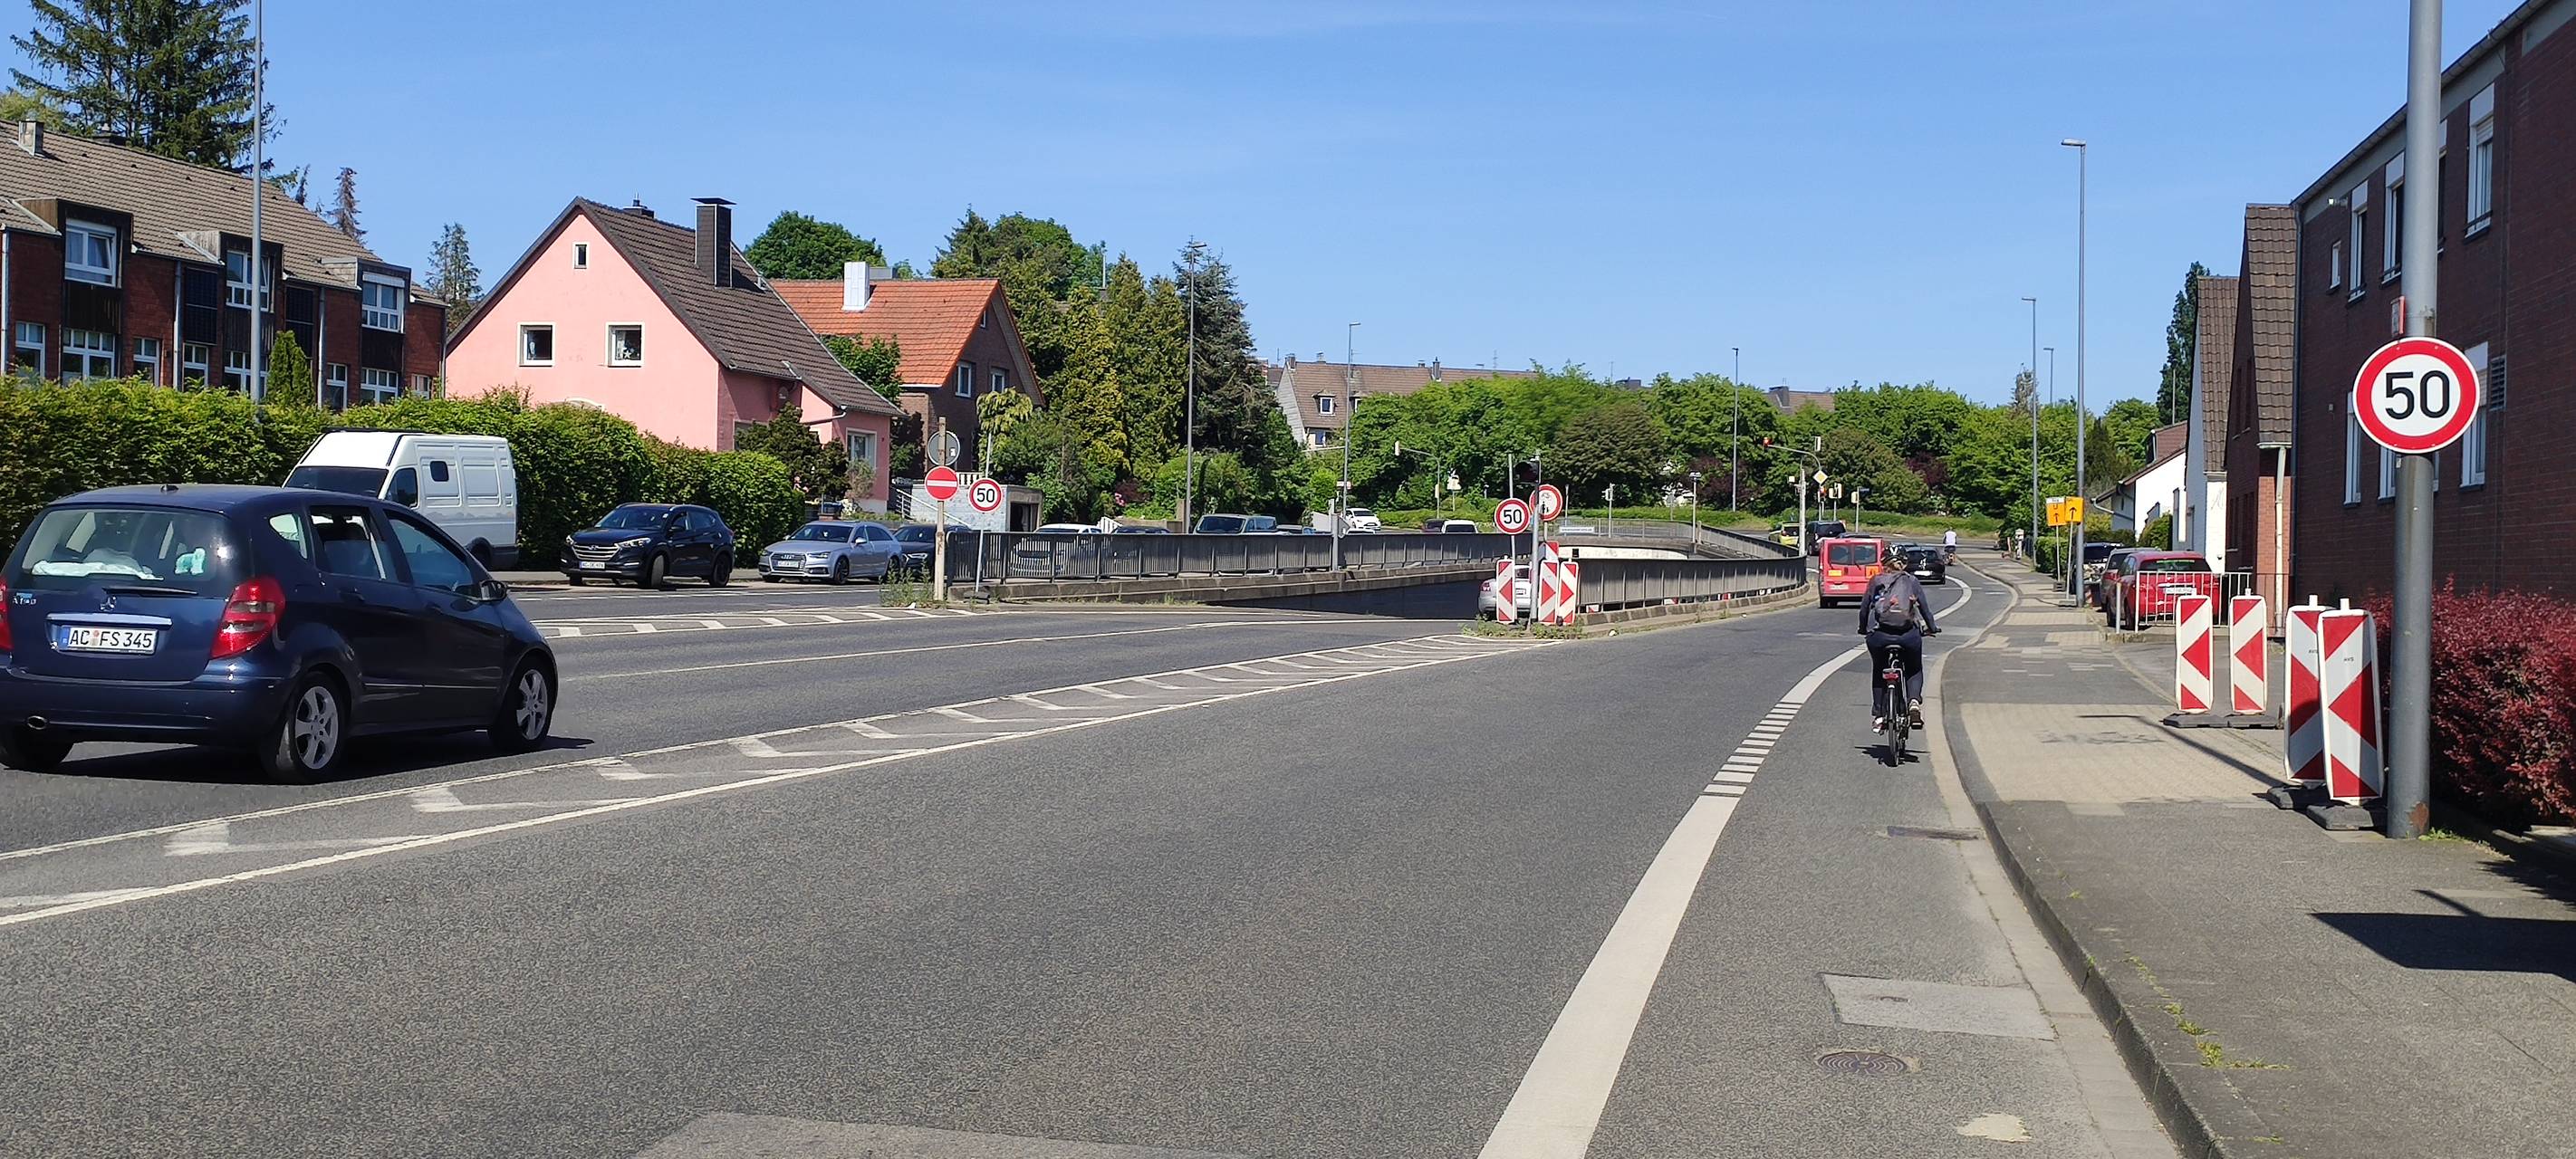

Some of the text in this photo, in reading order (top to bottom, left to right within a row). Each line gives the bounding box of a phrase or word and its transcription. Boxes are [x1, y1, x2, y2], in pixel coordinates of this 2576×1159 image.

[2385, 369, 2450, 420] 50
[976, 487, 995, 503] 50
[1504, 509, 1522, 524] 50
[70, 629, 152, 648] AC FS 345
